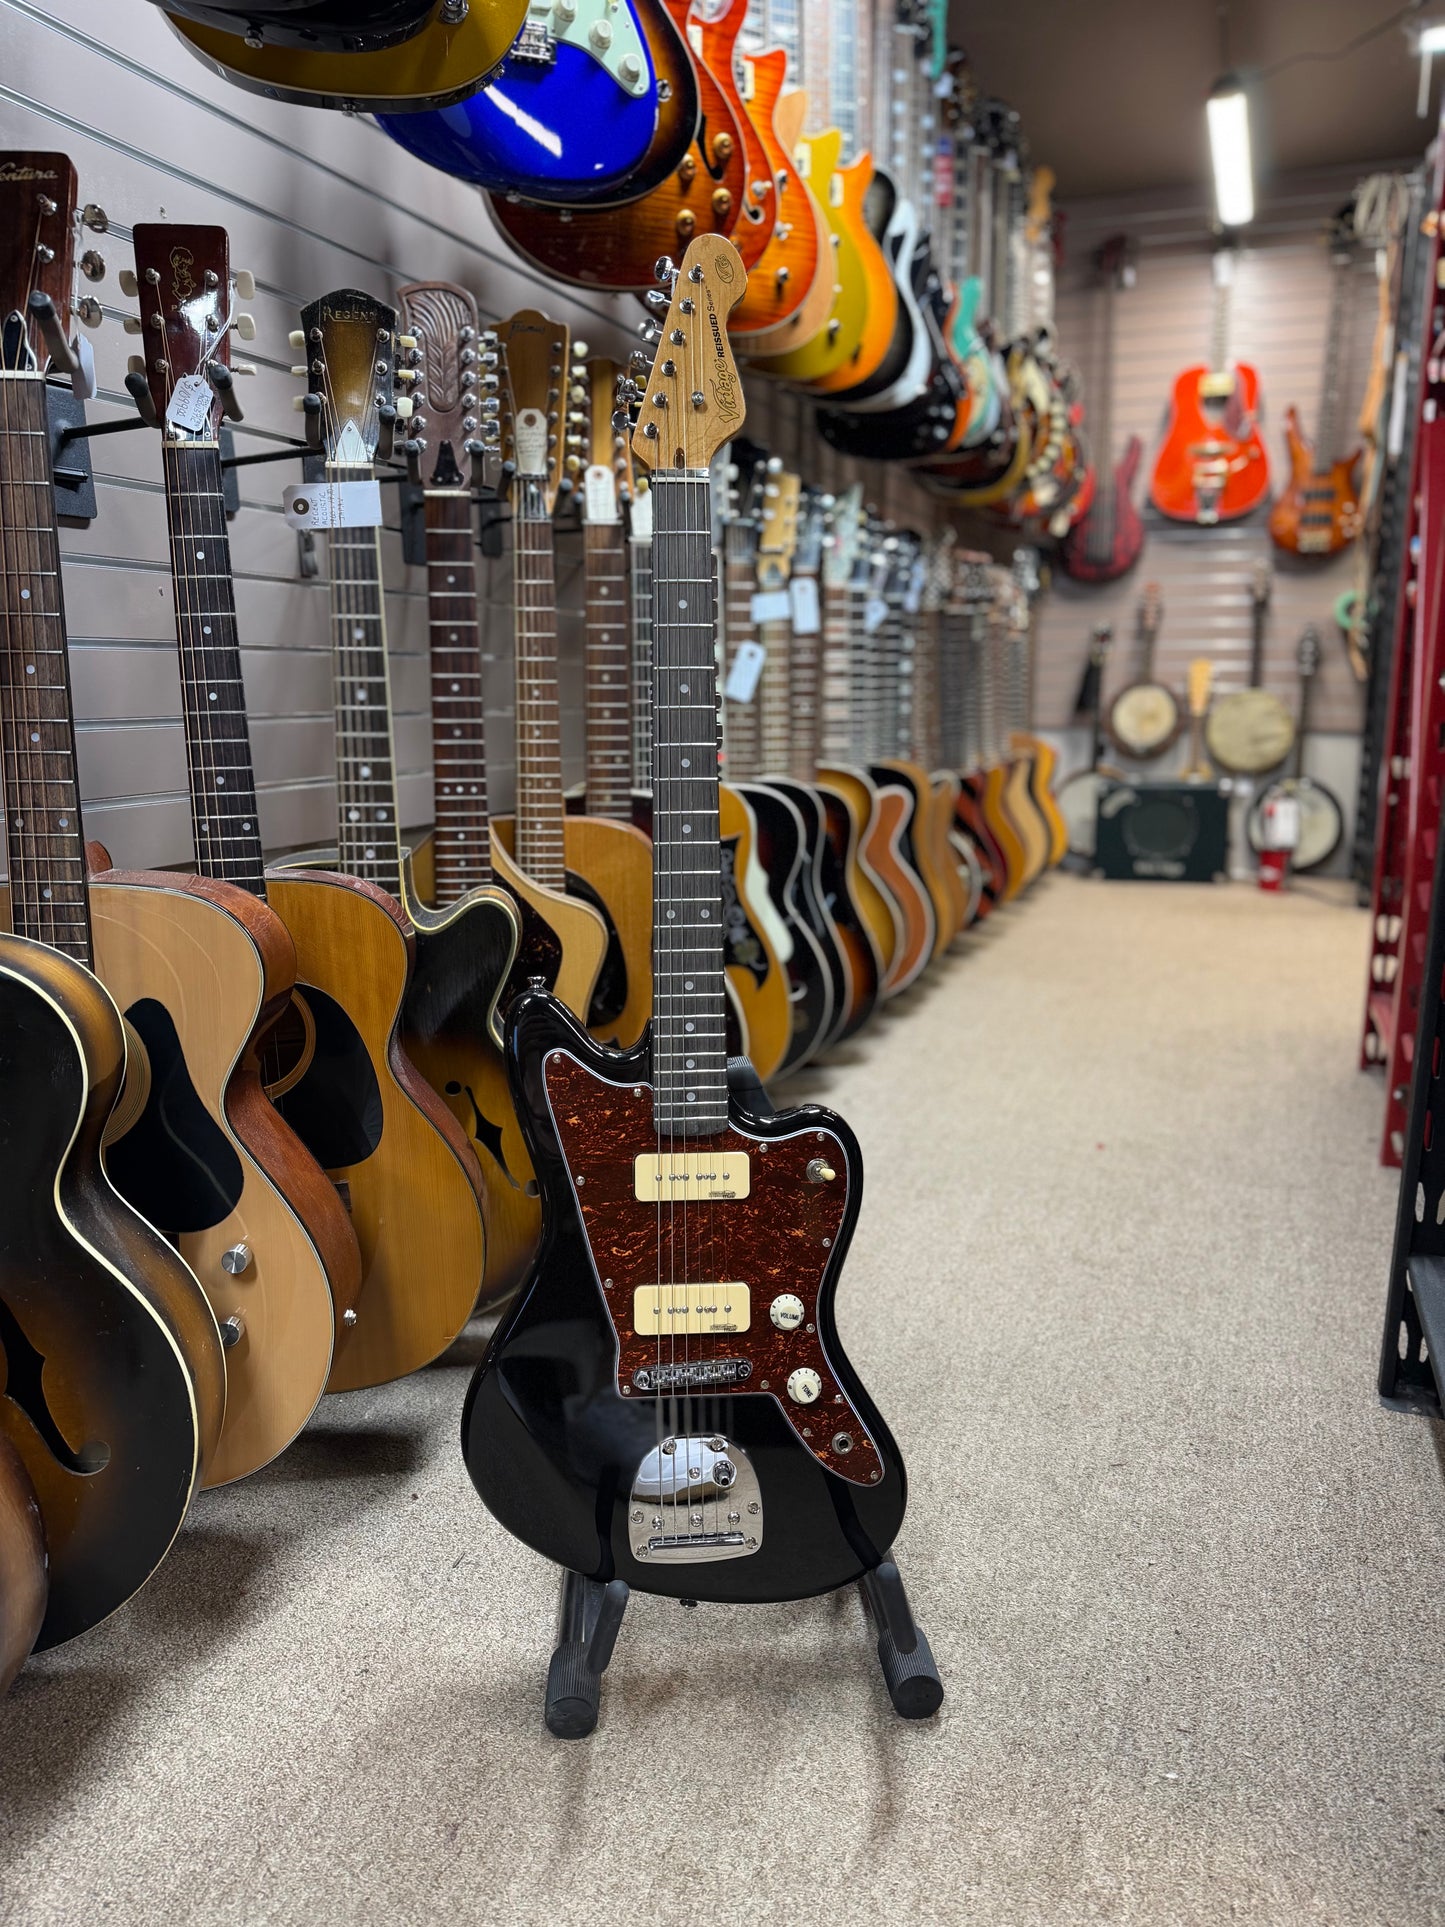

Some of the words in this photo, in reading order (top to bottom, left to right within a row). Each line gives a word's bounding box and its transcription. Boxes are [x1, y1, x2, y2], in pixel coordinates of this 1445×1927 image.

[709, 313, 725, 358] REISSUED
[709, 358, 740, 424] Vintage
[780, 1312, 800, 1321] VOLUME
[801, 1383, 814, 1398] TONE
